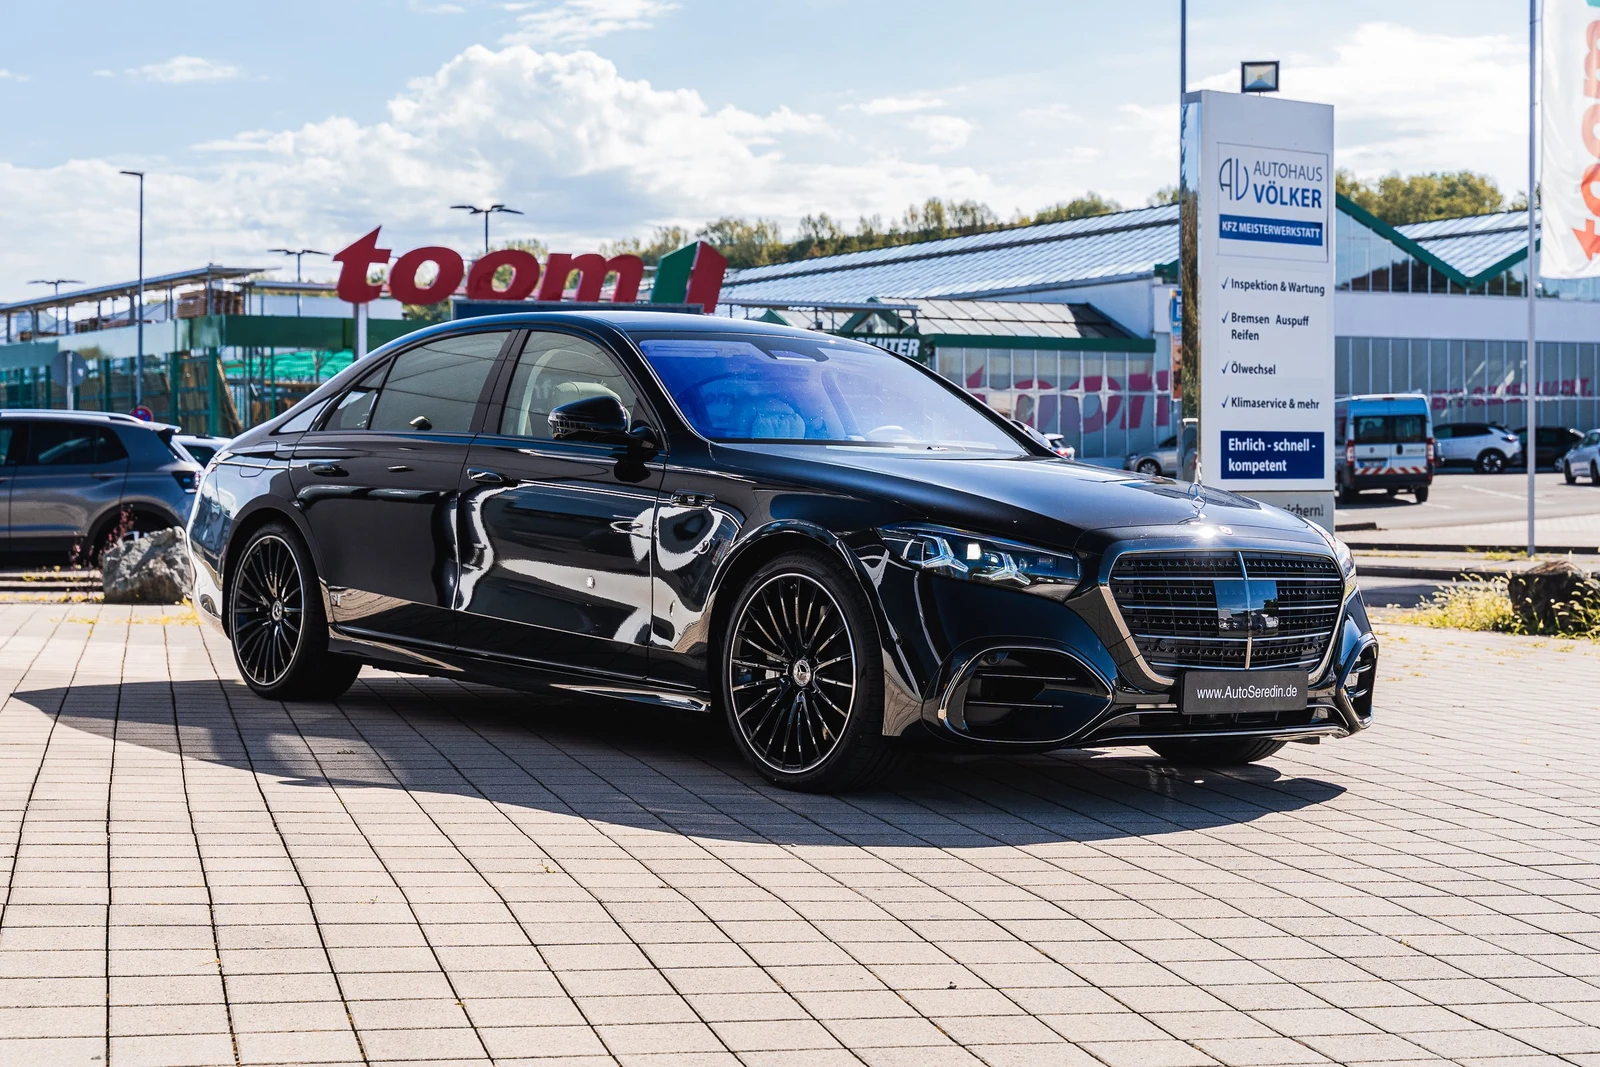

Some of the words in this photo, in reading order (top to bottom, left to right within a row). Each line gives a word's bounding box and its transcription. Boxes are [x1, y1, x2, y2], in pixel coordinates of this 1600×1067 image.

[1253, 160, 1323, 182] AUTOHAUS
[1253, 180, 1322, 209] VÖLKER
[1221, 221, 1238, 233] KFZ
[1238, 222, 1321, 239] MEISTERWERKSTATT
[333, 224, 645, 304] toom
[1231, 278, 1278, 292] Inspektion
[1279, 281, 1287, 292] &
[1288, 282, 1325, 297] Wartung
[1231, 312, 1270, 325] Bremsen
[1275, 314, 1310, 328] Auspuff
[1231, 329, 1260, 341] Reifen
[1231, 361, 1276, 375] Ölwechsel
[1231, 397, 1287, 409] Klimaservice
[1288, 398, 1296, 409] &
[1297, 398, 1320, 410] mehr
[1228, 437, 1266, 452] Ehrlich
[1273, 438, 1310, 452] schnell
[1228, 458, 1287, 475] kompetent
[1196, 684, 1298, 700] www.AutoSeredin.de
